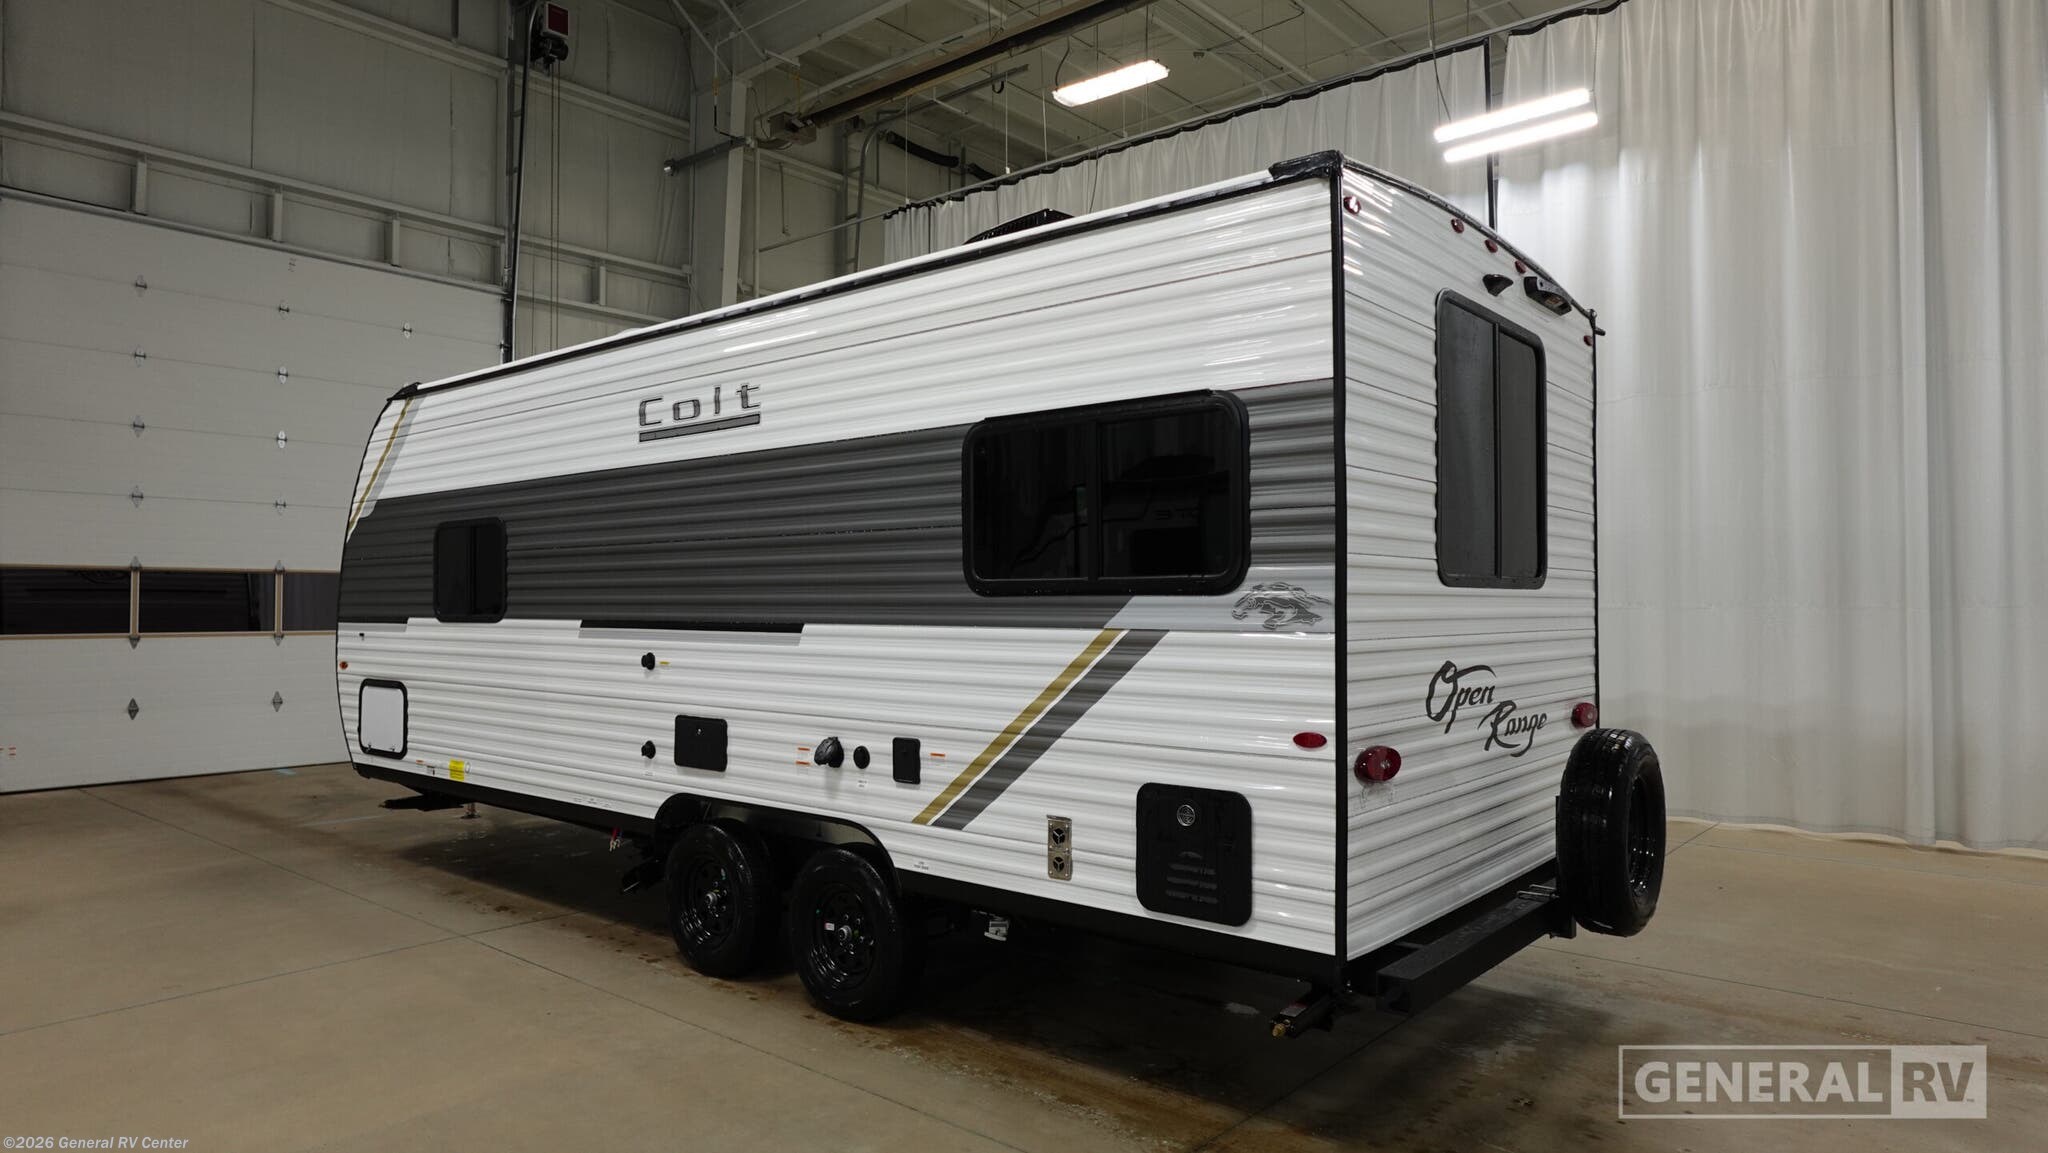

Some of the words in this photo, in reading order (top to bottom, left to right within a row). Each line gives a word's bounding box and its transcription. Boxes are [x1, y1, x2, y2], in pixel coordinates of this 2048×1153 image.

[639, 385, 760, 426] Colt
[1426, 661, 1497, 734] Open
[1477, 700, 1547, 757] Range
